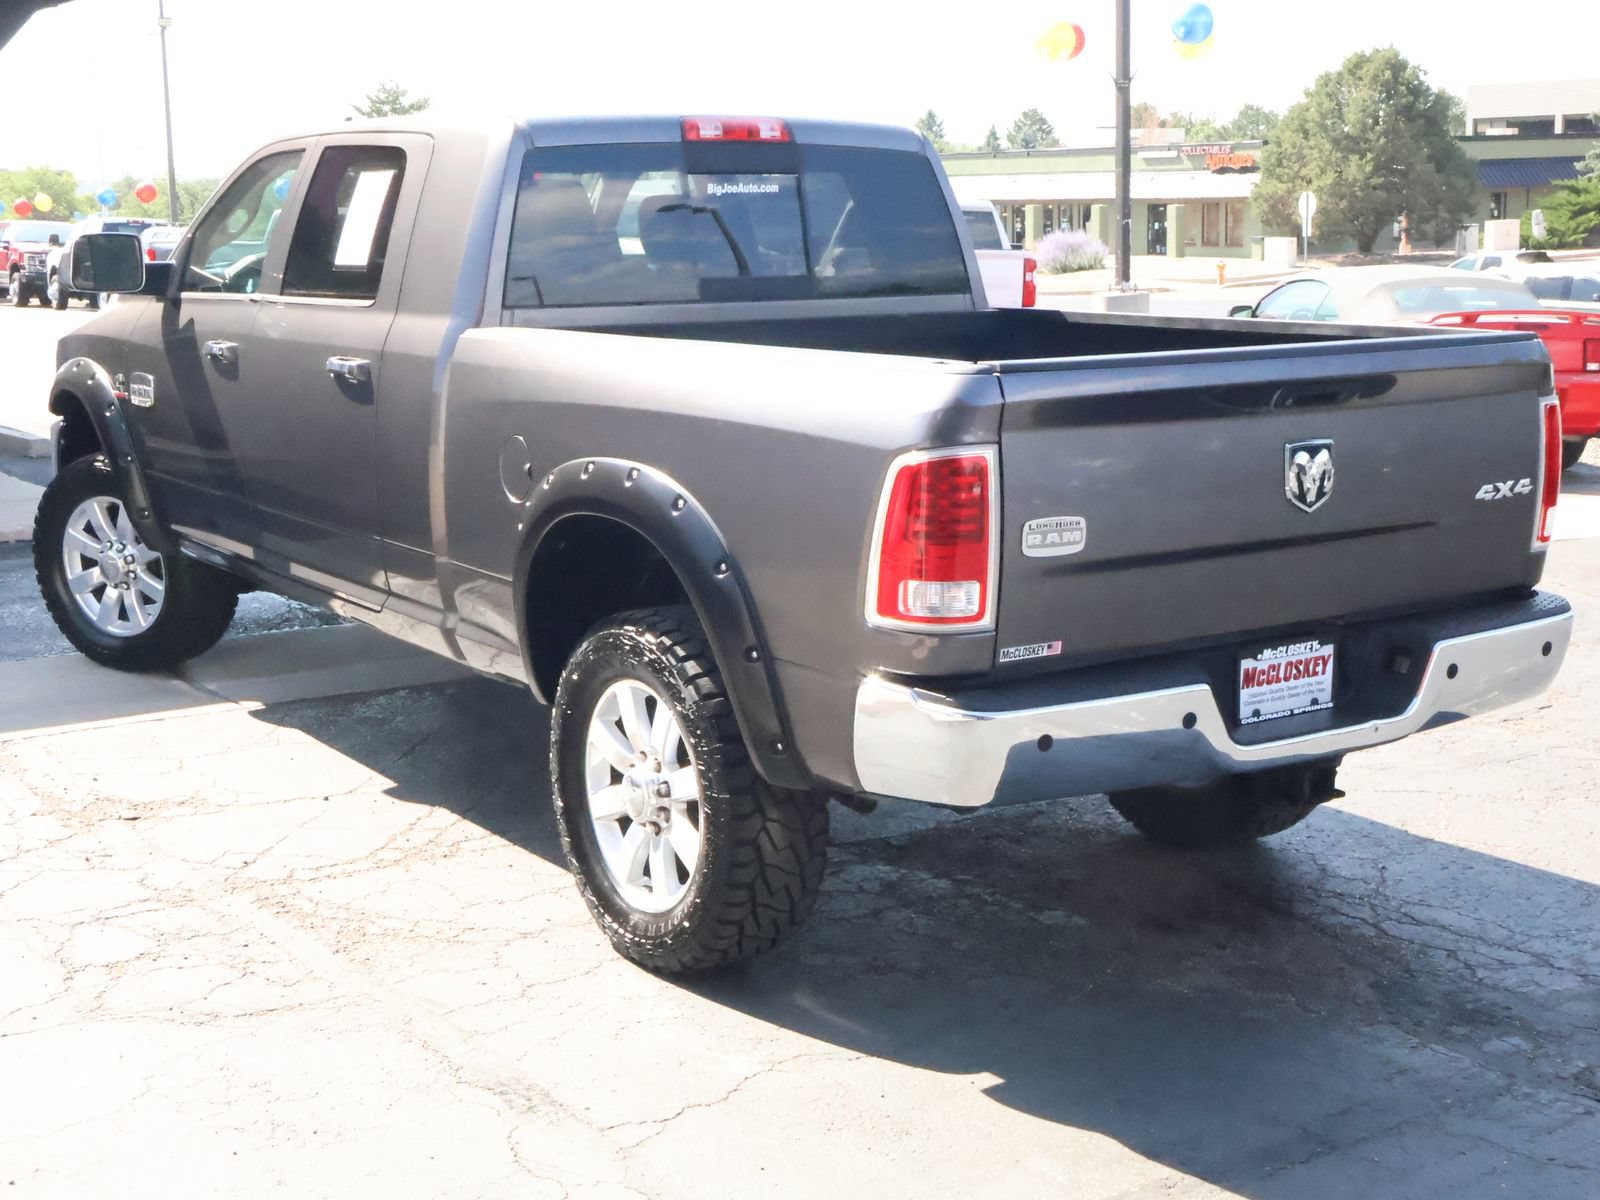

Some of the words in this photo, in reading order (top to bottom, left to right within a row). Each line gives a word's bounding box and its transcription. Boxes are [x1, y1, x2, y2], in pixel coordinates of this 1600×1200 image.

[1180, 146, 1230, 155] COLLECTABLES
[707, 182, 779, 196] BigJoeAuto.com
[1027, 531, 1082, 546] RAM
[1001, 645, 1046, 660] McCLOSKEY
[1241, 655, 1331, 688] McCLOSKEY
[1241, 711, 1290, 724] COLORADO
[1293, 703, 1333, 714] SPRINGS
